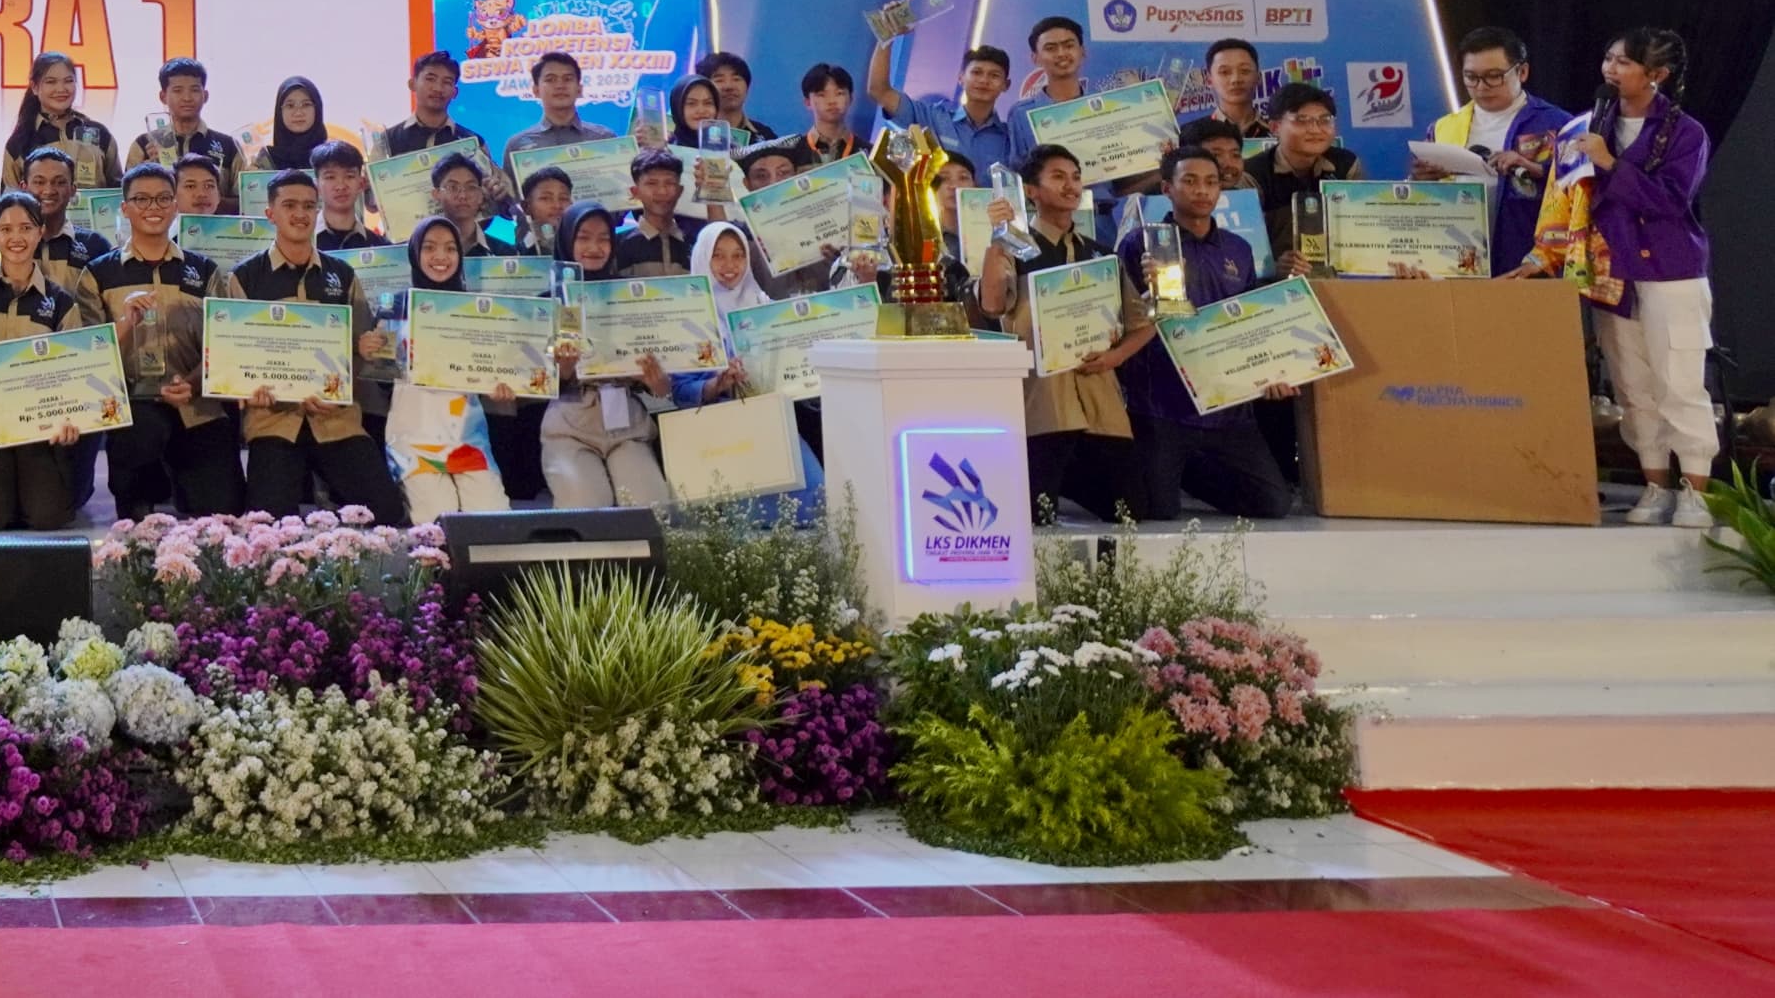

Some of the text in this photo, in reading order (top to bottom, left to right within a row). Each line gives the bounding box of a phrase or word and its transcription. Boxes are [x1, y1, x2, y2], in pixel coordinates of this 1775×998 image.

[1146, 5, 1244, 24] Puspresnas
[1265, 8, 1312, 23] BPTI
[528, 17, 602, 37] LOMBA
[504, 38, 632, 56] KOMPETENSI
[463, 59, 524, 79] SISWA
[609, 54, 673, 71] XXXIII
[502, 79, 533, 91] JAW
[596, 73, 630, 86] 2025
[925, 535, 1011, 549] LKS DIKMEN
